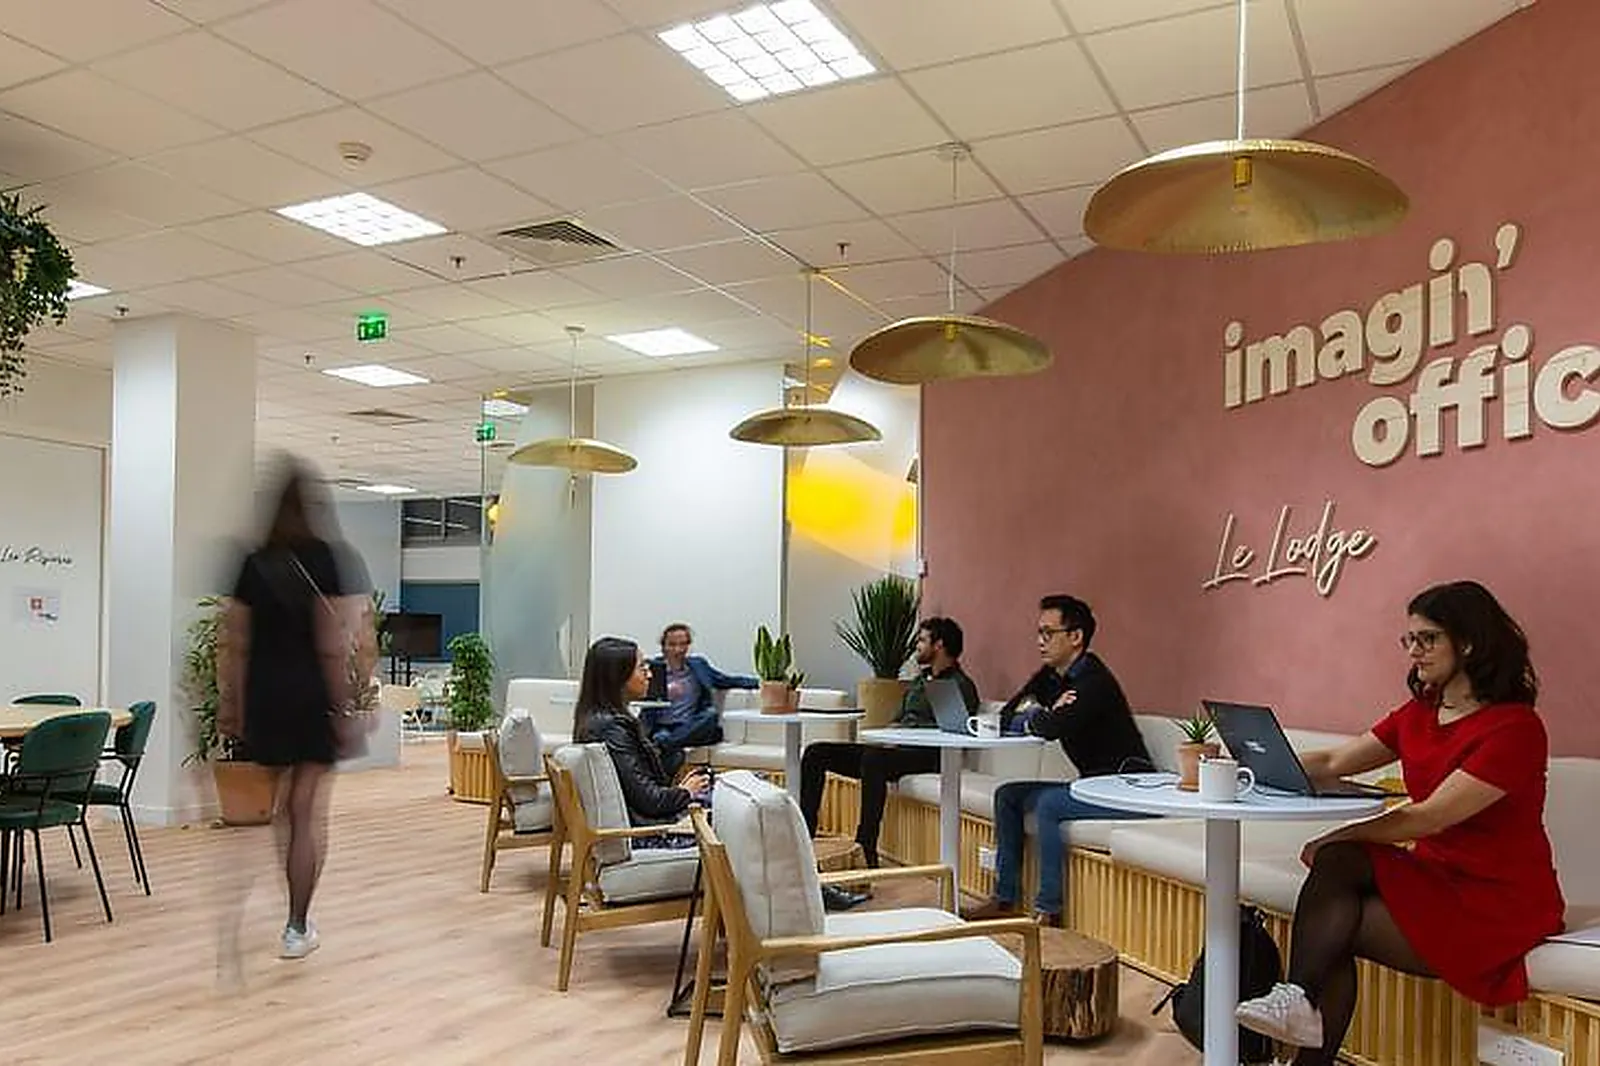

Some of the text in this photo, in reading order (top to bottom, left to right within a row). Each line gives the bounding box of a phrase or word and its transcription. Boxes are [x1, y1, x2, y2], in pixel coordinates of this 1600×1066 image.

[1224, 223, 1518, 408] imagin'
[1352, 324, 1600, 466] offic
[1202, 500, 1374, 595] Le Lodge
